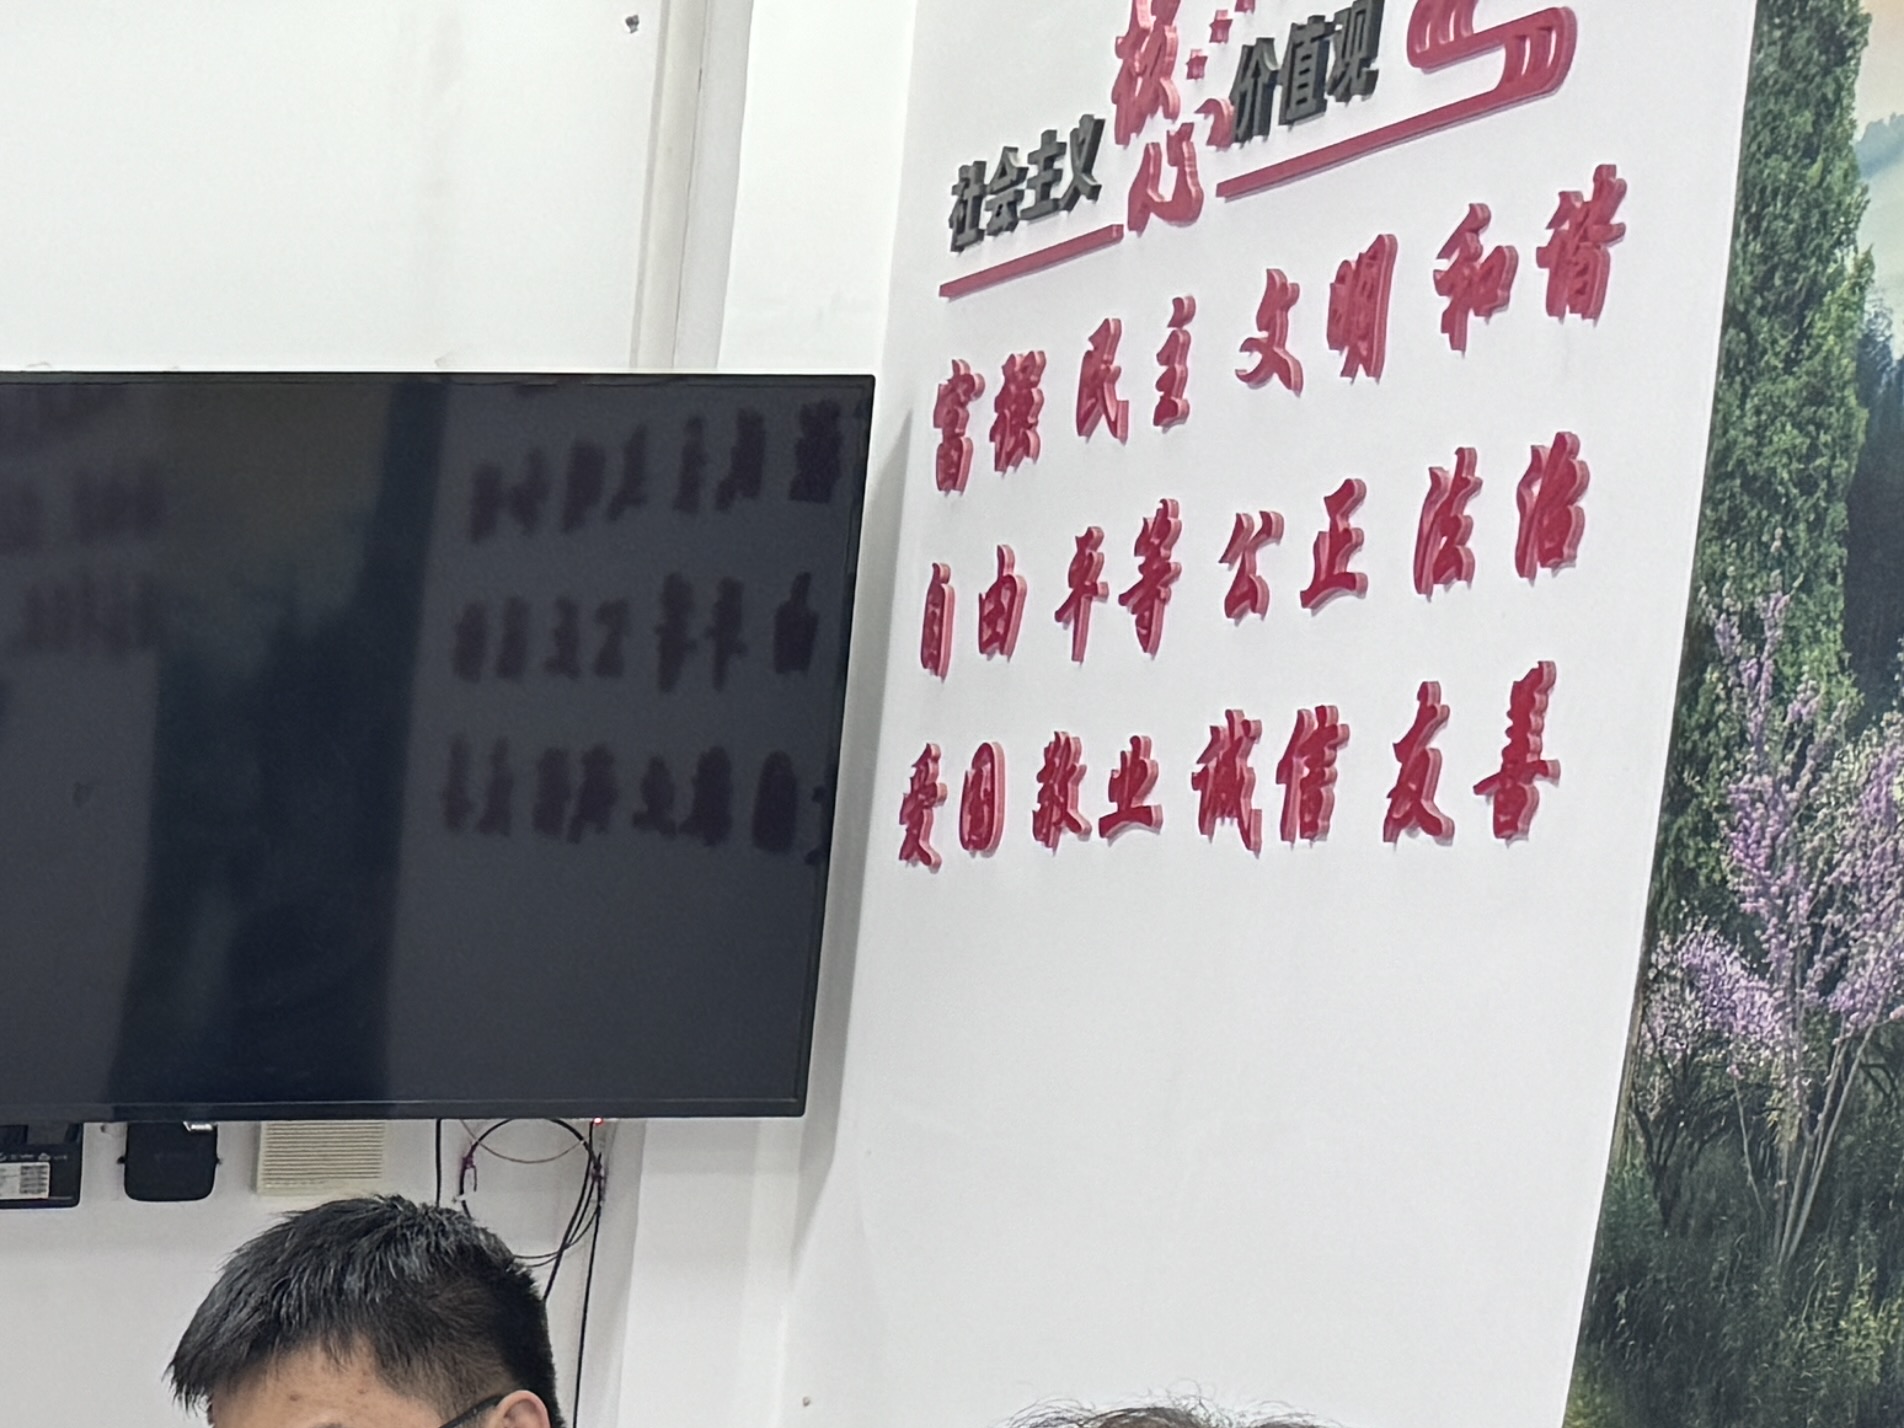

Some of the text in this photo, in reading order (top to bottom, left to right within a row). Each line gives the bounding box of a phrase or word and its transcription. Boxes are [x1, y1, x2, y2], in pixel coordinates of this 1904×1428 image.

[949, 113, 1105, 252] 社会主义
[1230, 0, 1386, 144] 价值观
